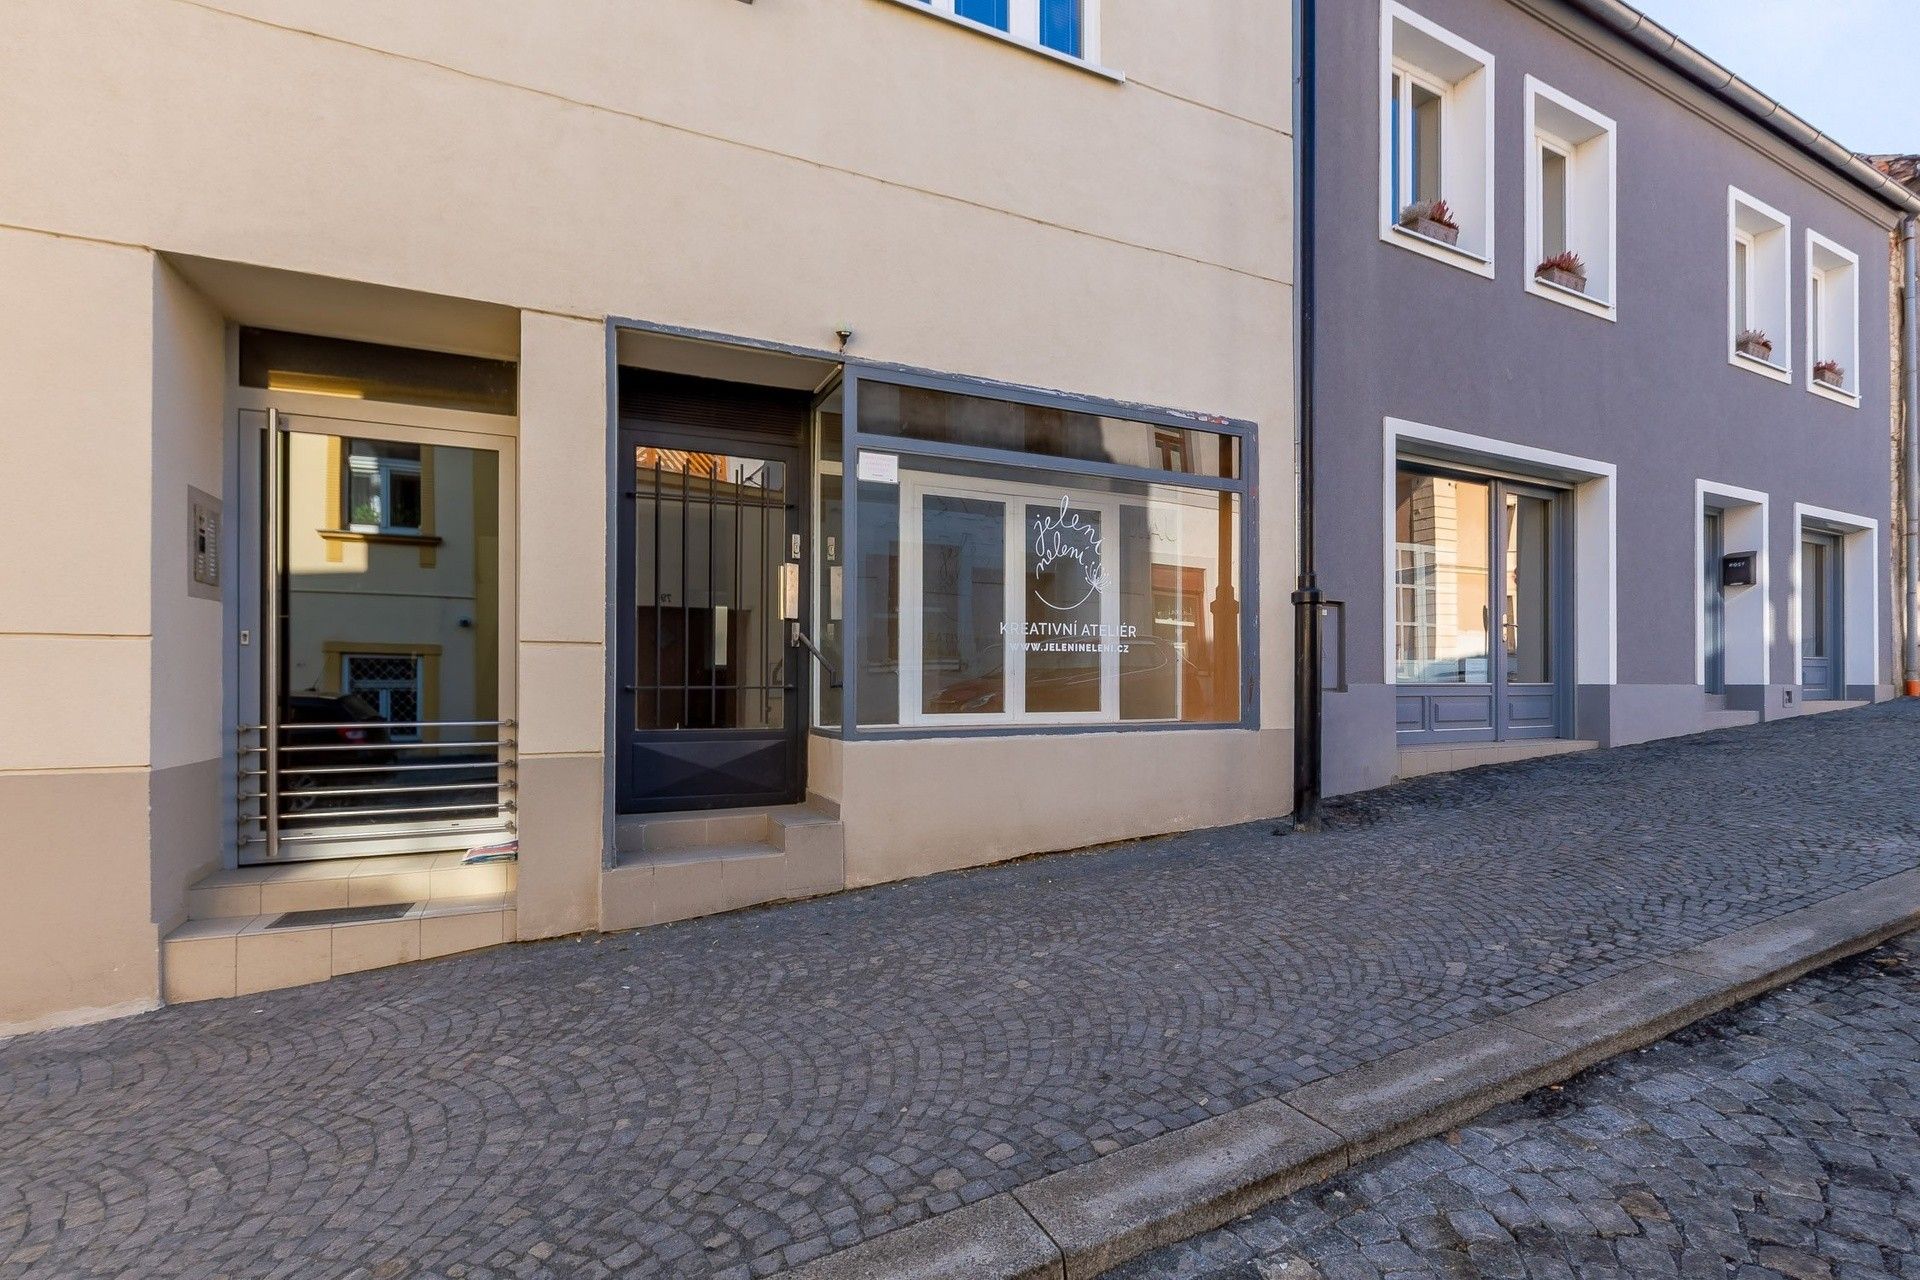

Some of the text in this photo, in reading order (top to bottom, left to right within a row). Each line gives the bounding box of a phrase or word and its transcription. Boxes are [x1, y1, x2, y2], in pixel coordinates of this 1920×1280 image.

[1000, 620, 1137, 638] KREATIVNÍ ATELIÉR
[1009, 643, 1129, 653] WWW.JELENINELENI.CZ
